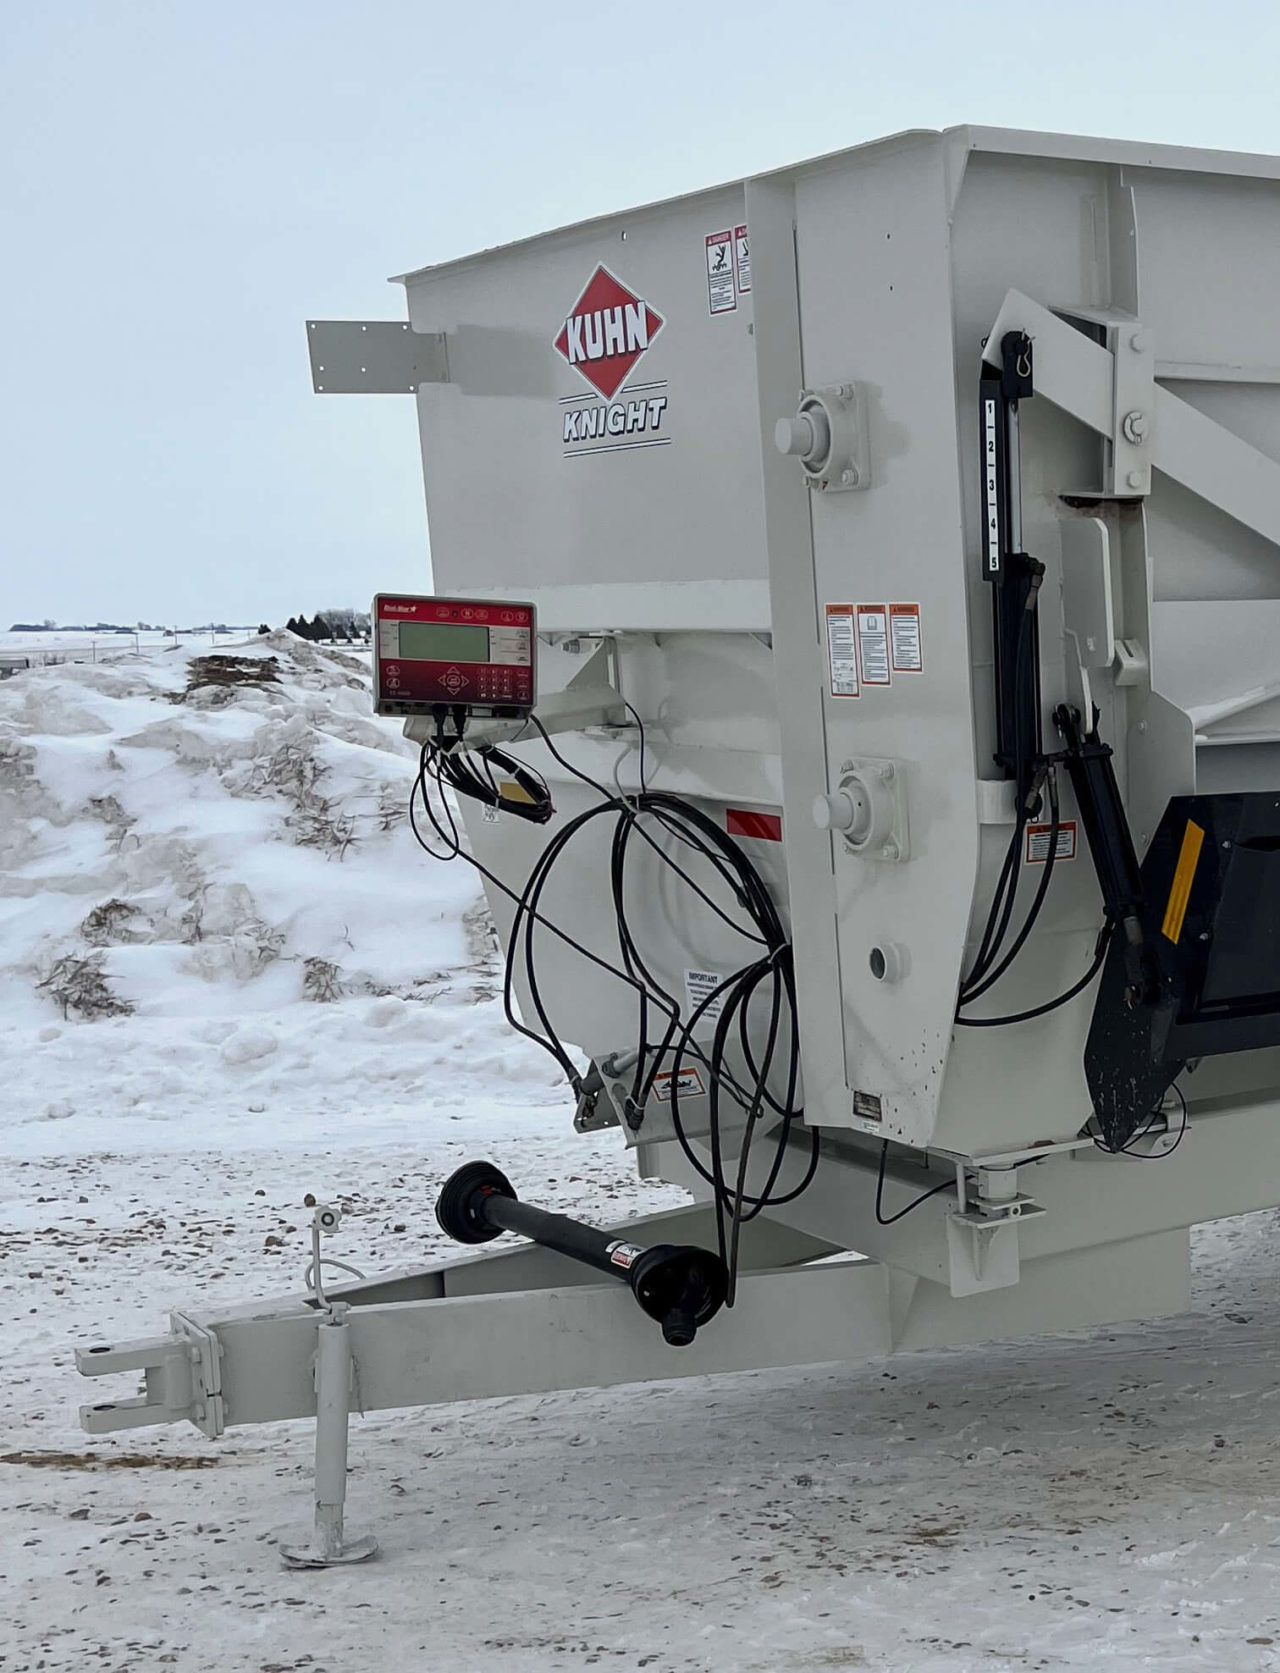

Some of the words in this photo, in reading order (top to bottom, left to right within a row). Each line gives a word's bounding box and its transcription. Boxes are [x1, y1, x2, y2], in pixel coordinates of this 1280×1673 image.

[567, 301, 649, 364] KUHN
[563, 397, 668, 442] KNIGHT
[988, 441, 995, 452] 2
[989, 479, 995, 491] 3
[990, 518, 996, 529] 4
[991, 557, 998, 568] 5
